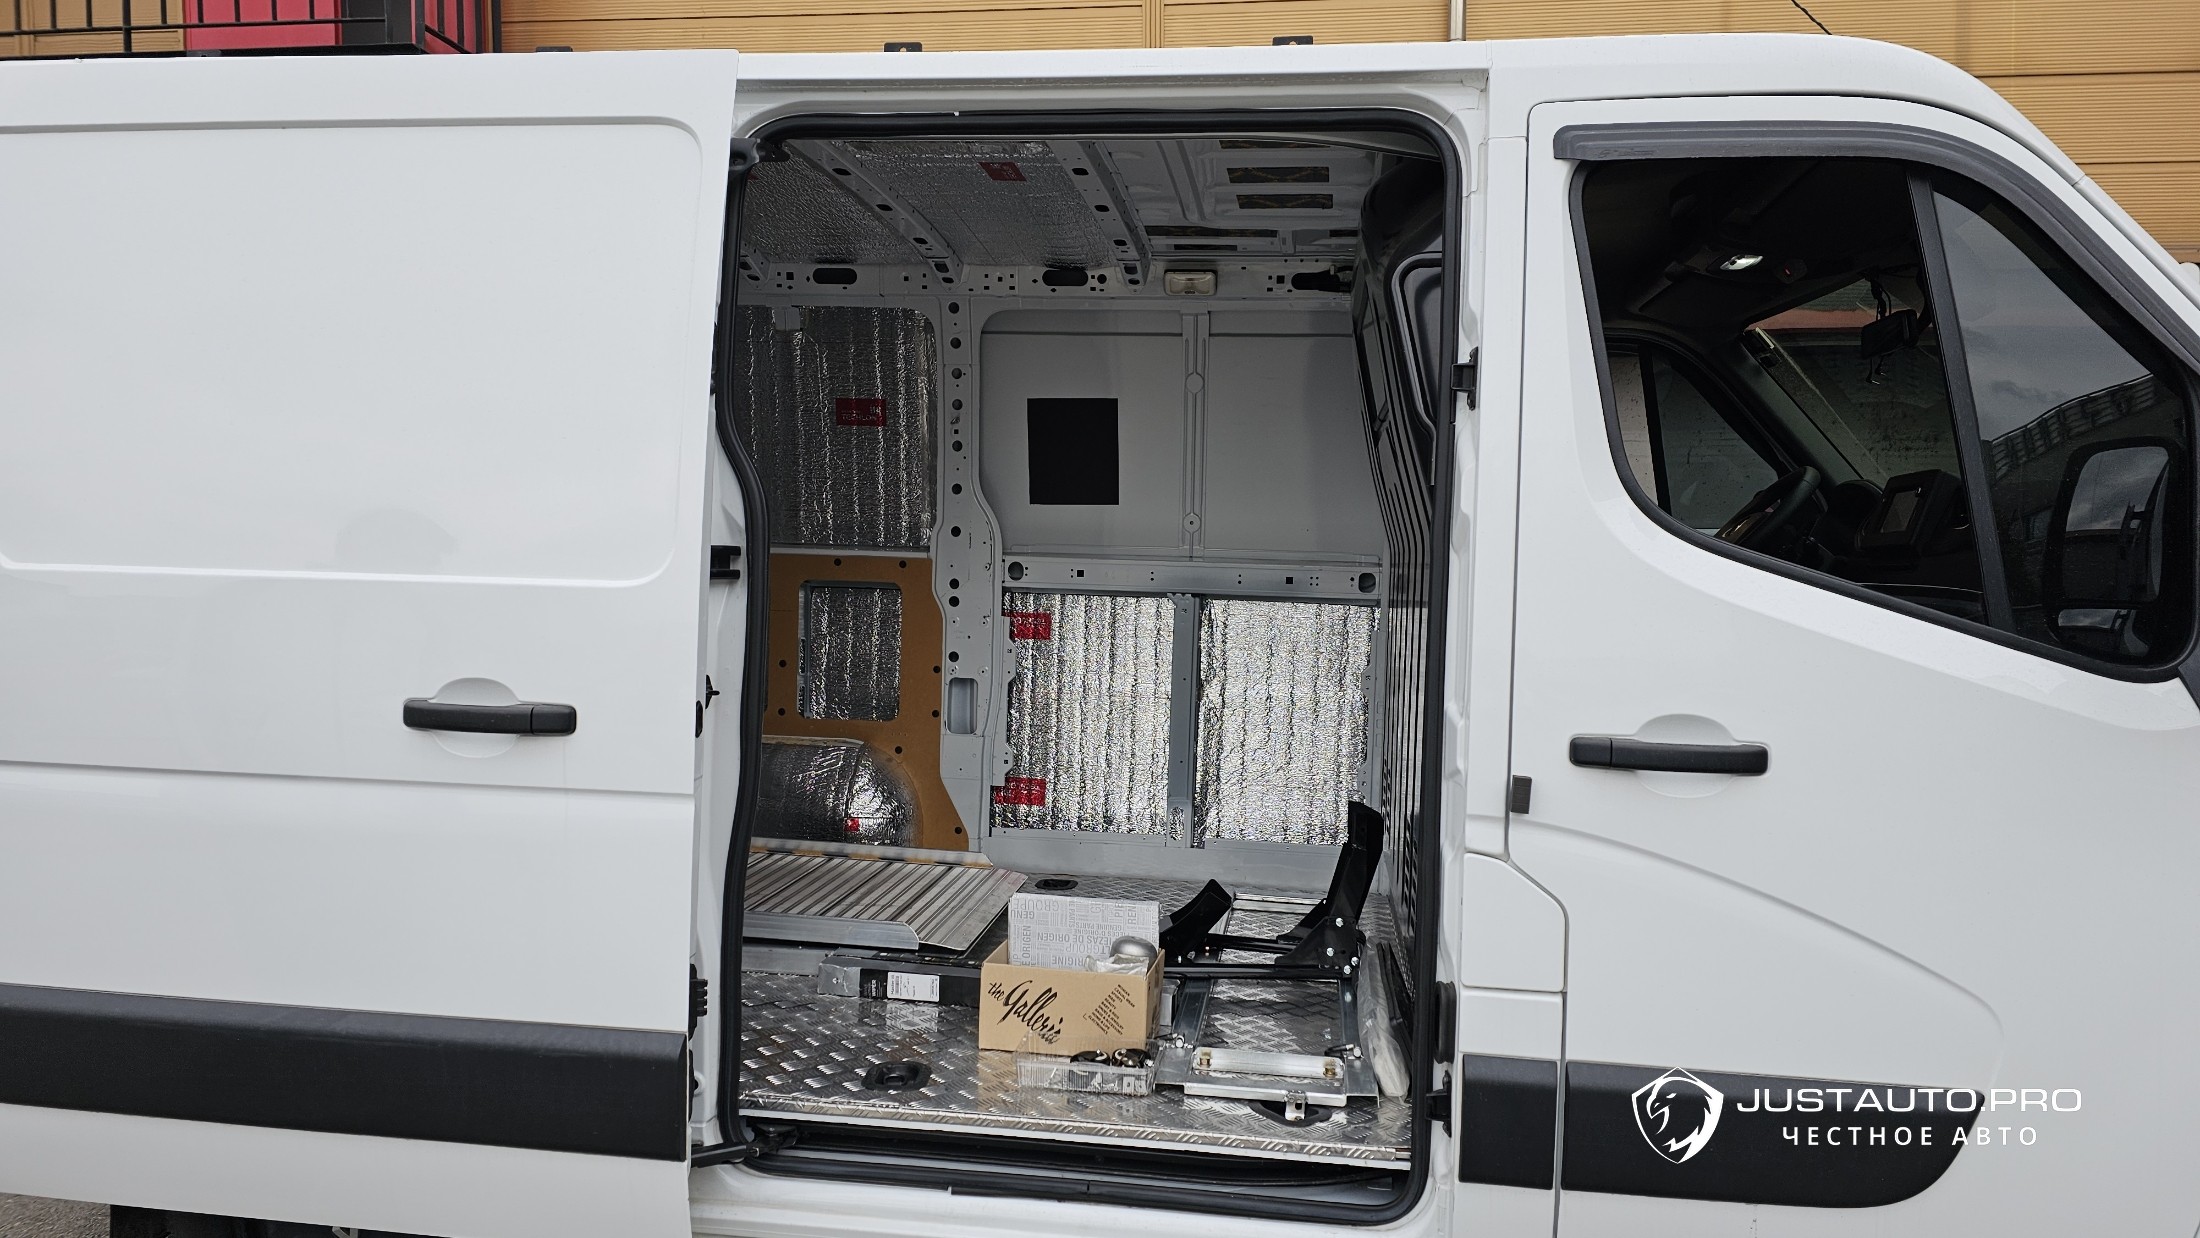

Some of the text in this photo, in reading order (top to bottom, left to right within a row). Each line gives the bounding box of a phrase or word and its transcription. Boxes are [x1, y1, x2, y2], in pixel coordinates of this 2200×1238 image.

[1022, 925, 1031, 959] ORIGEN
[1037, 932, 1112, 946] IEZAS DE ORIGEN
[1051, 955, 1085, 967] RIGINE
[988, 982, 1005, 1001] the
